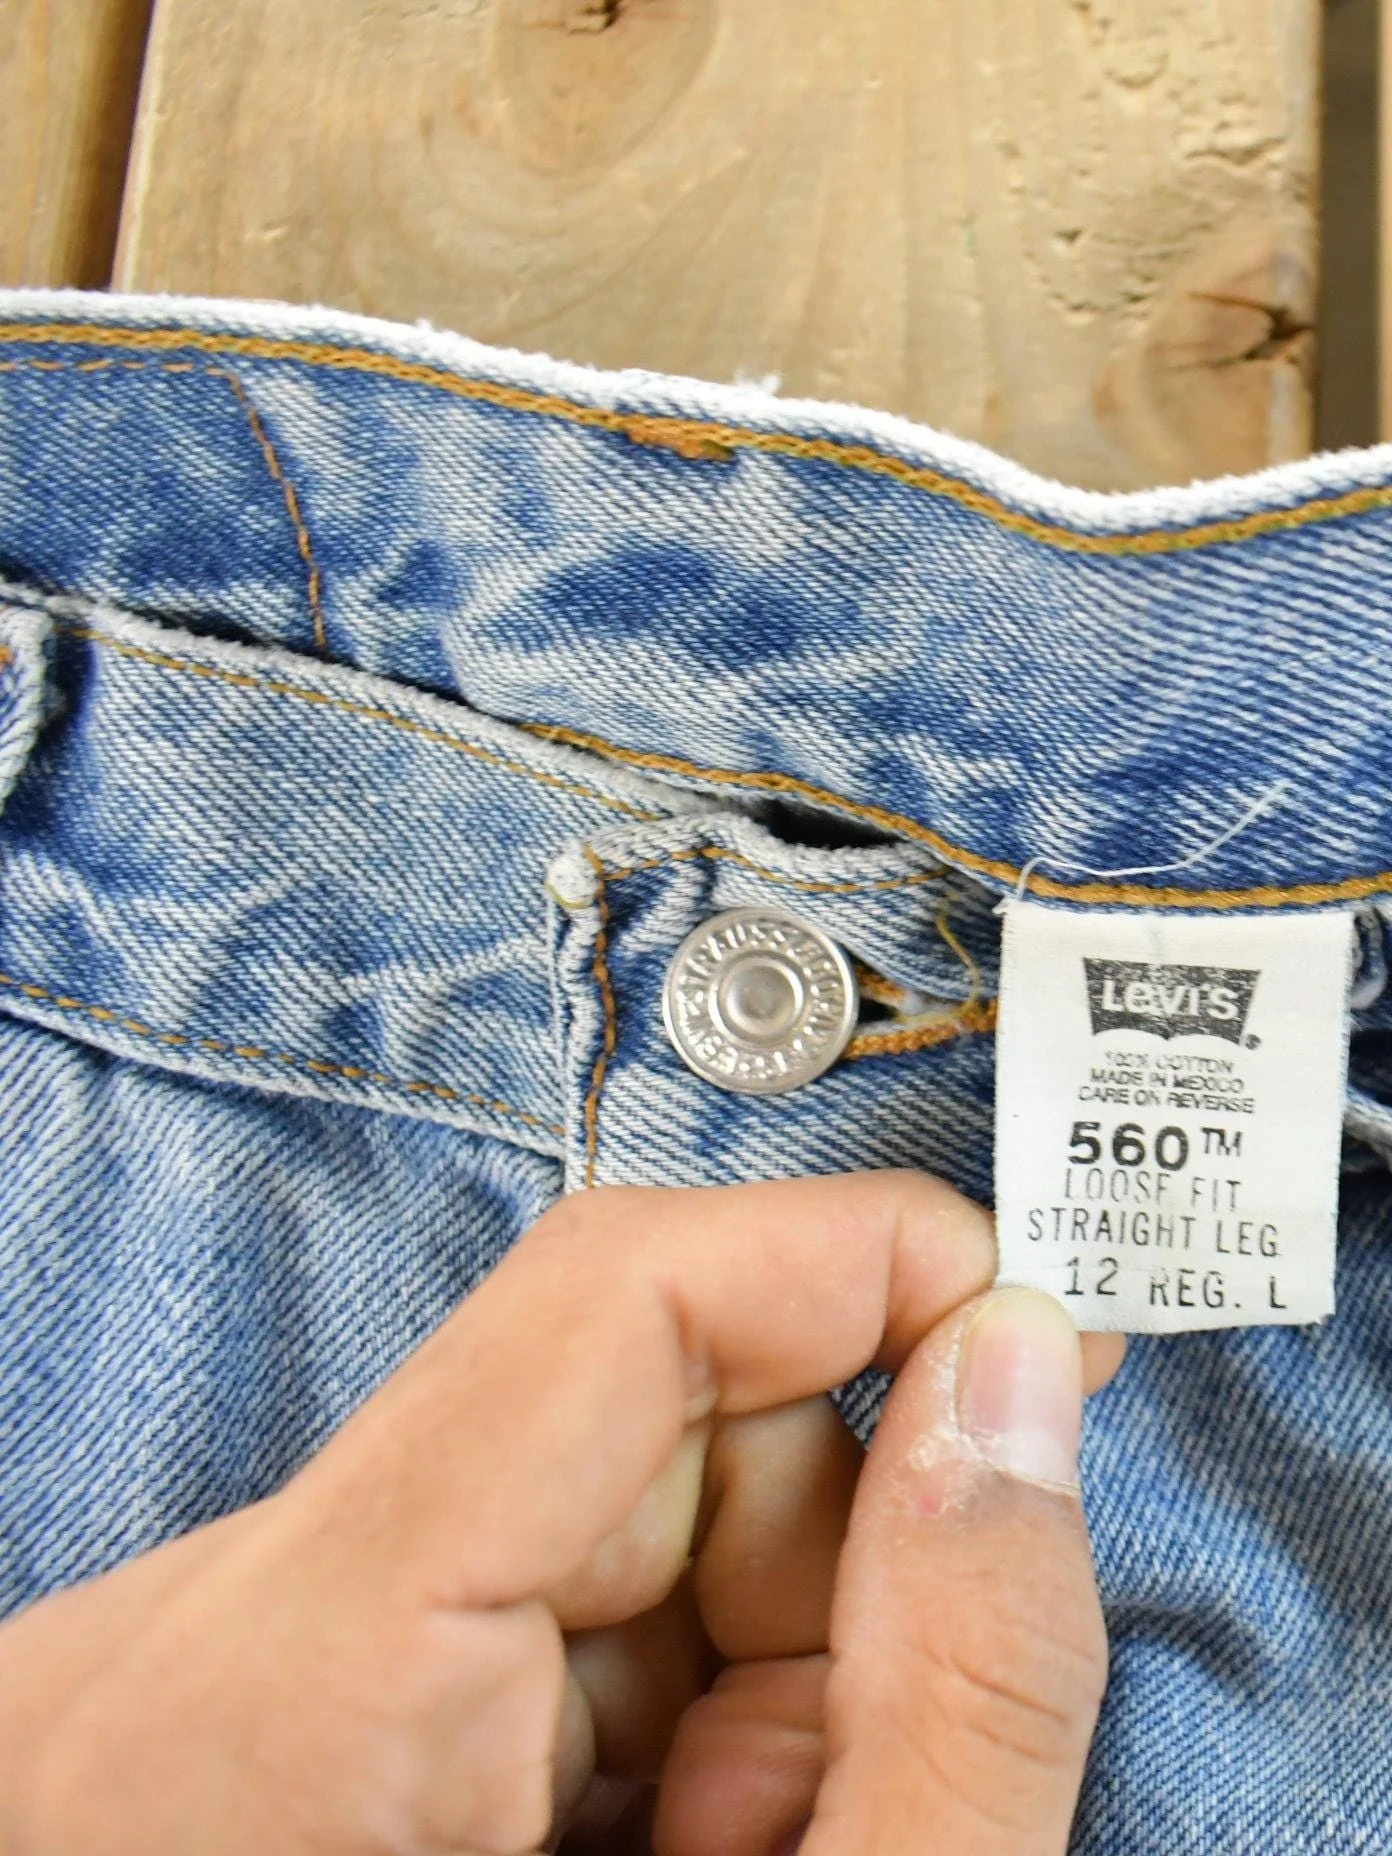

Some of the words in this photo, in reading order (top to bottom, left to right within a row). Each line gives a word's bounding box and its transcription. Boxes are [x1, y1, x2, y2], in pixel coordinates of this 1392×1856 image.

[1091, 1067, 1143, 1085] MADE
[1149, 1071, 1168, 1088] IN
[1171, 1075, 1244, 1094] MEXICO
[1156, 1053, 1235, 1074] COTTON
[1078, 1085, 1131, 1106] CARE
[1134, 1088, 1160, 1107] ON
[1166, 1092, 1256, 1114] REVERSE
[1065, 1168, 1171, 1205] LOOSE
[1190, 1176, 1242, 1212] FIT
[1028, 1207, 1197, 1249] STRAIGHT
[1216, 1219, 1280, 1257] LEG
[1064, 1256, 1119, 1297] 12
[1150, 1268, 1242, 1310] REG.
[1267, 1275, 1288, 1310] L
